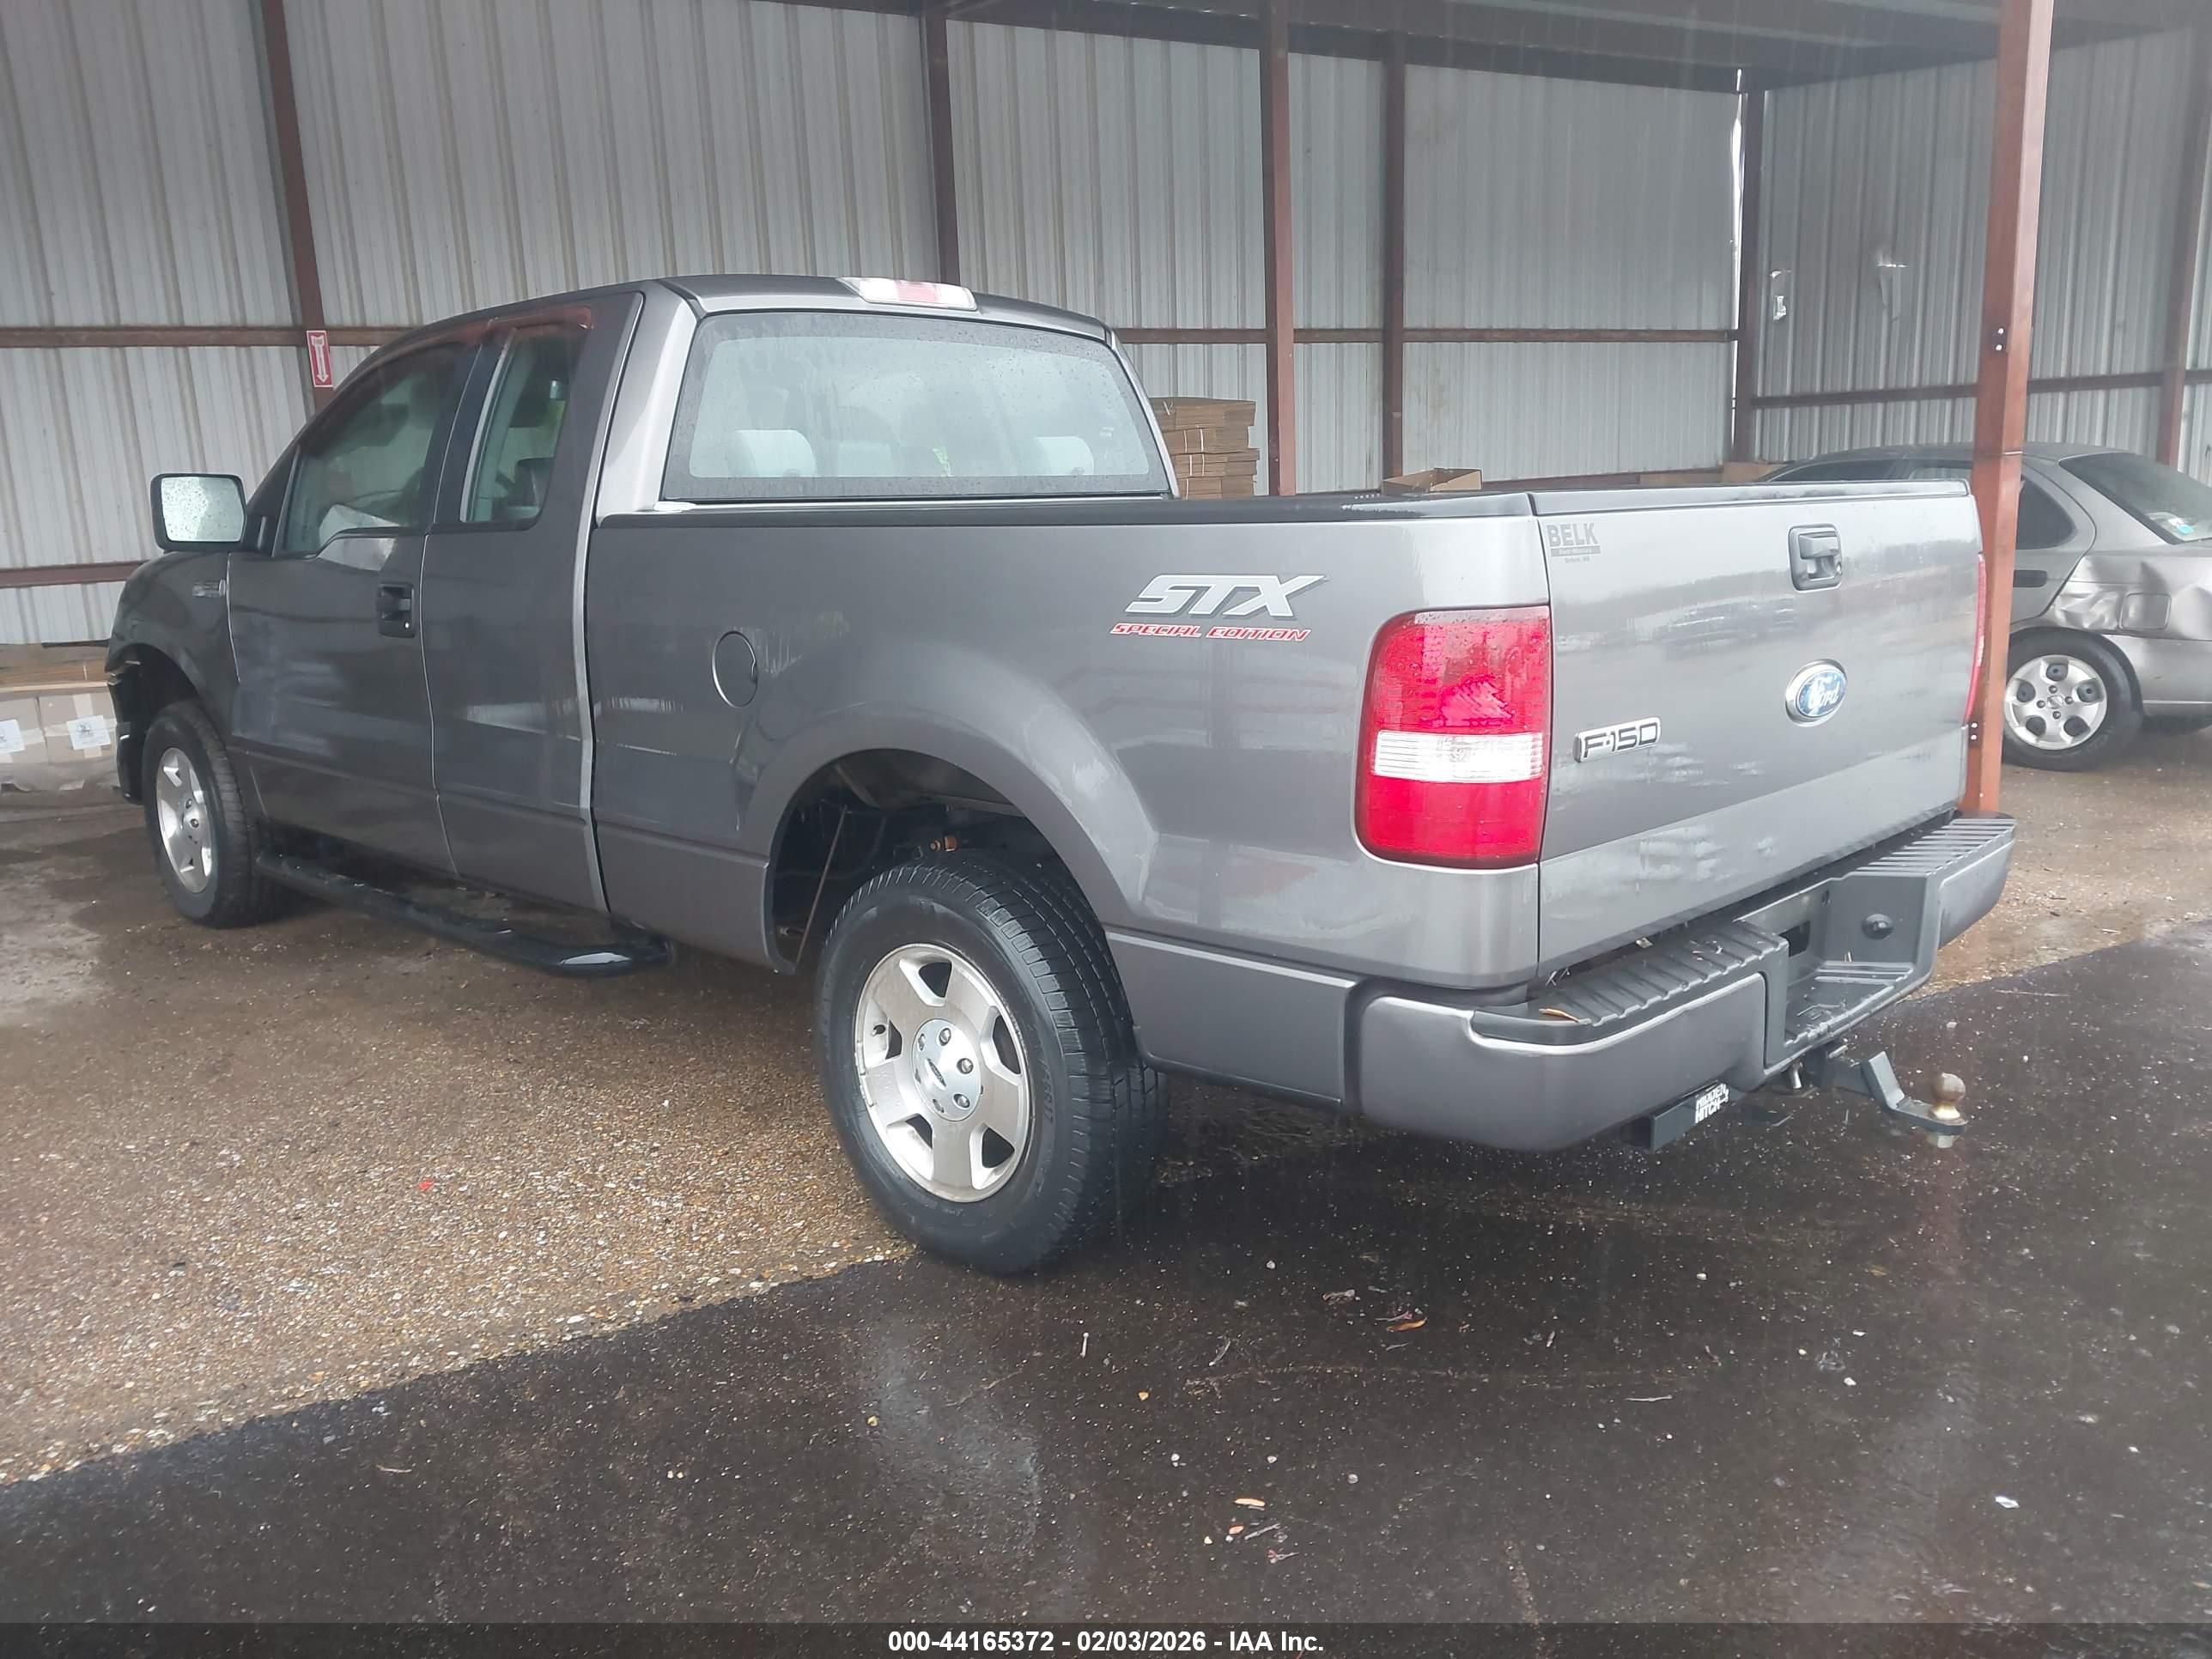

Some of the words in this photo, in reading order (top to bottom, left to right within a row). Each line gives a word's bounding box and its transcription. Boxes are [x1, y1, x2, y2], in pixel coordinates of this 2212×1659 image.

[1547, 522, 1598, 547] BELK
[1124, 574, 1327, 619] STX
[1109, 623, 1202, 638] SPECIAL
[1206, 625, 1312, 641] EDITION
[1807, 675, 1841, 710] Ford
[1695, 1097, 1721, 1123] HITCH
